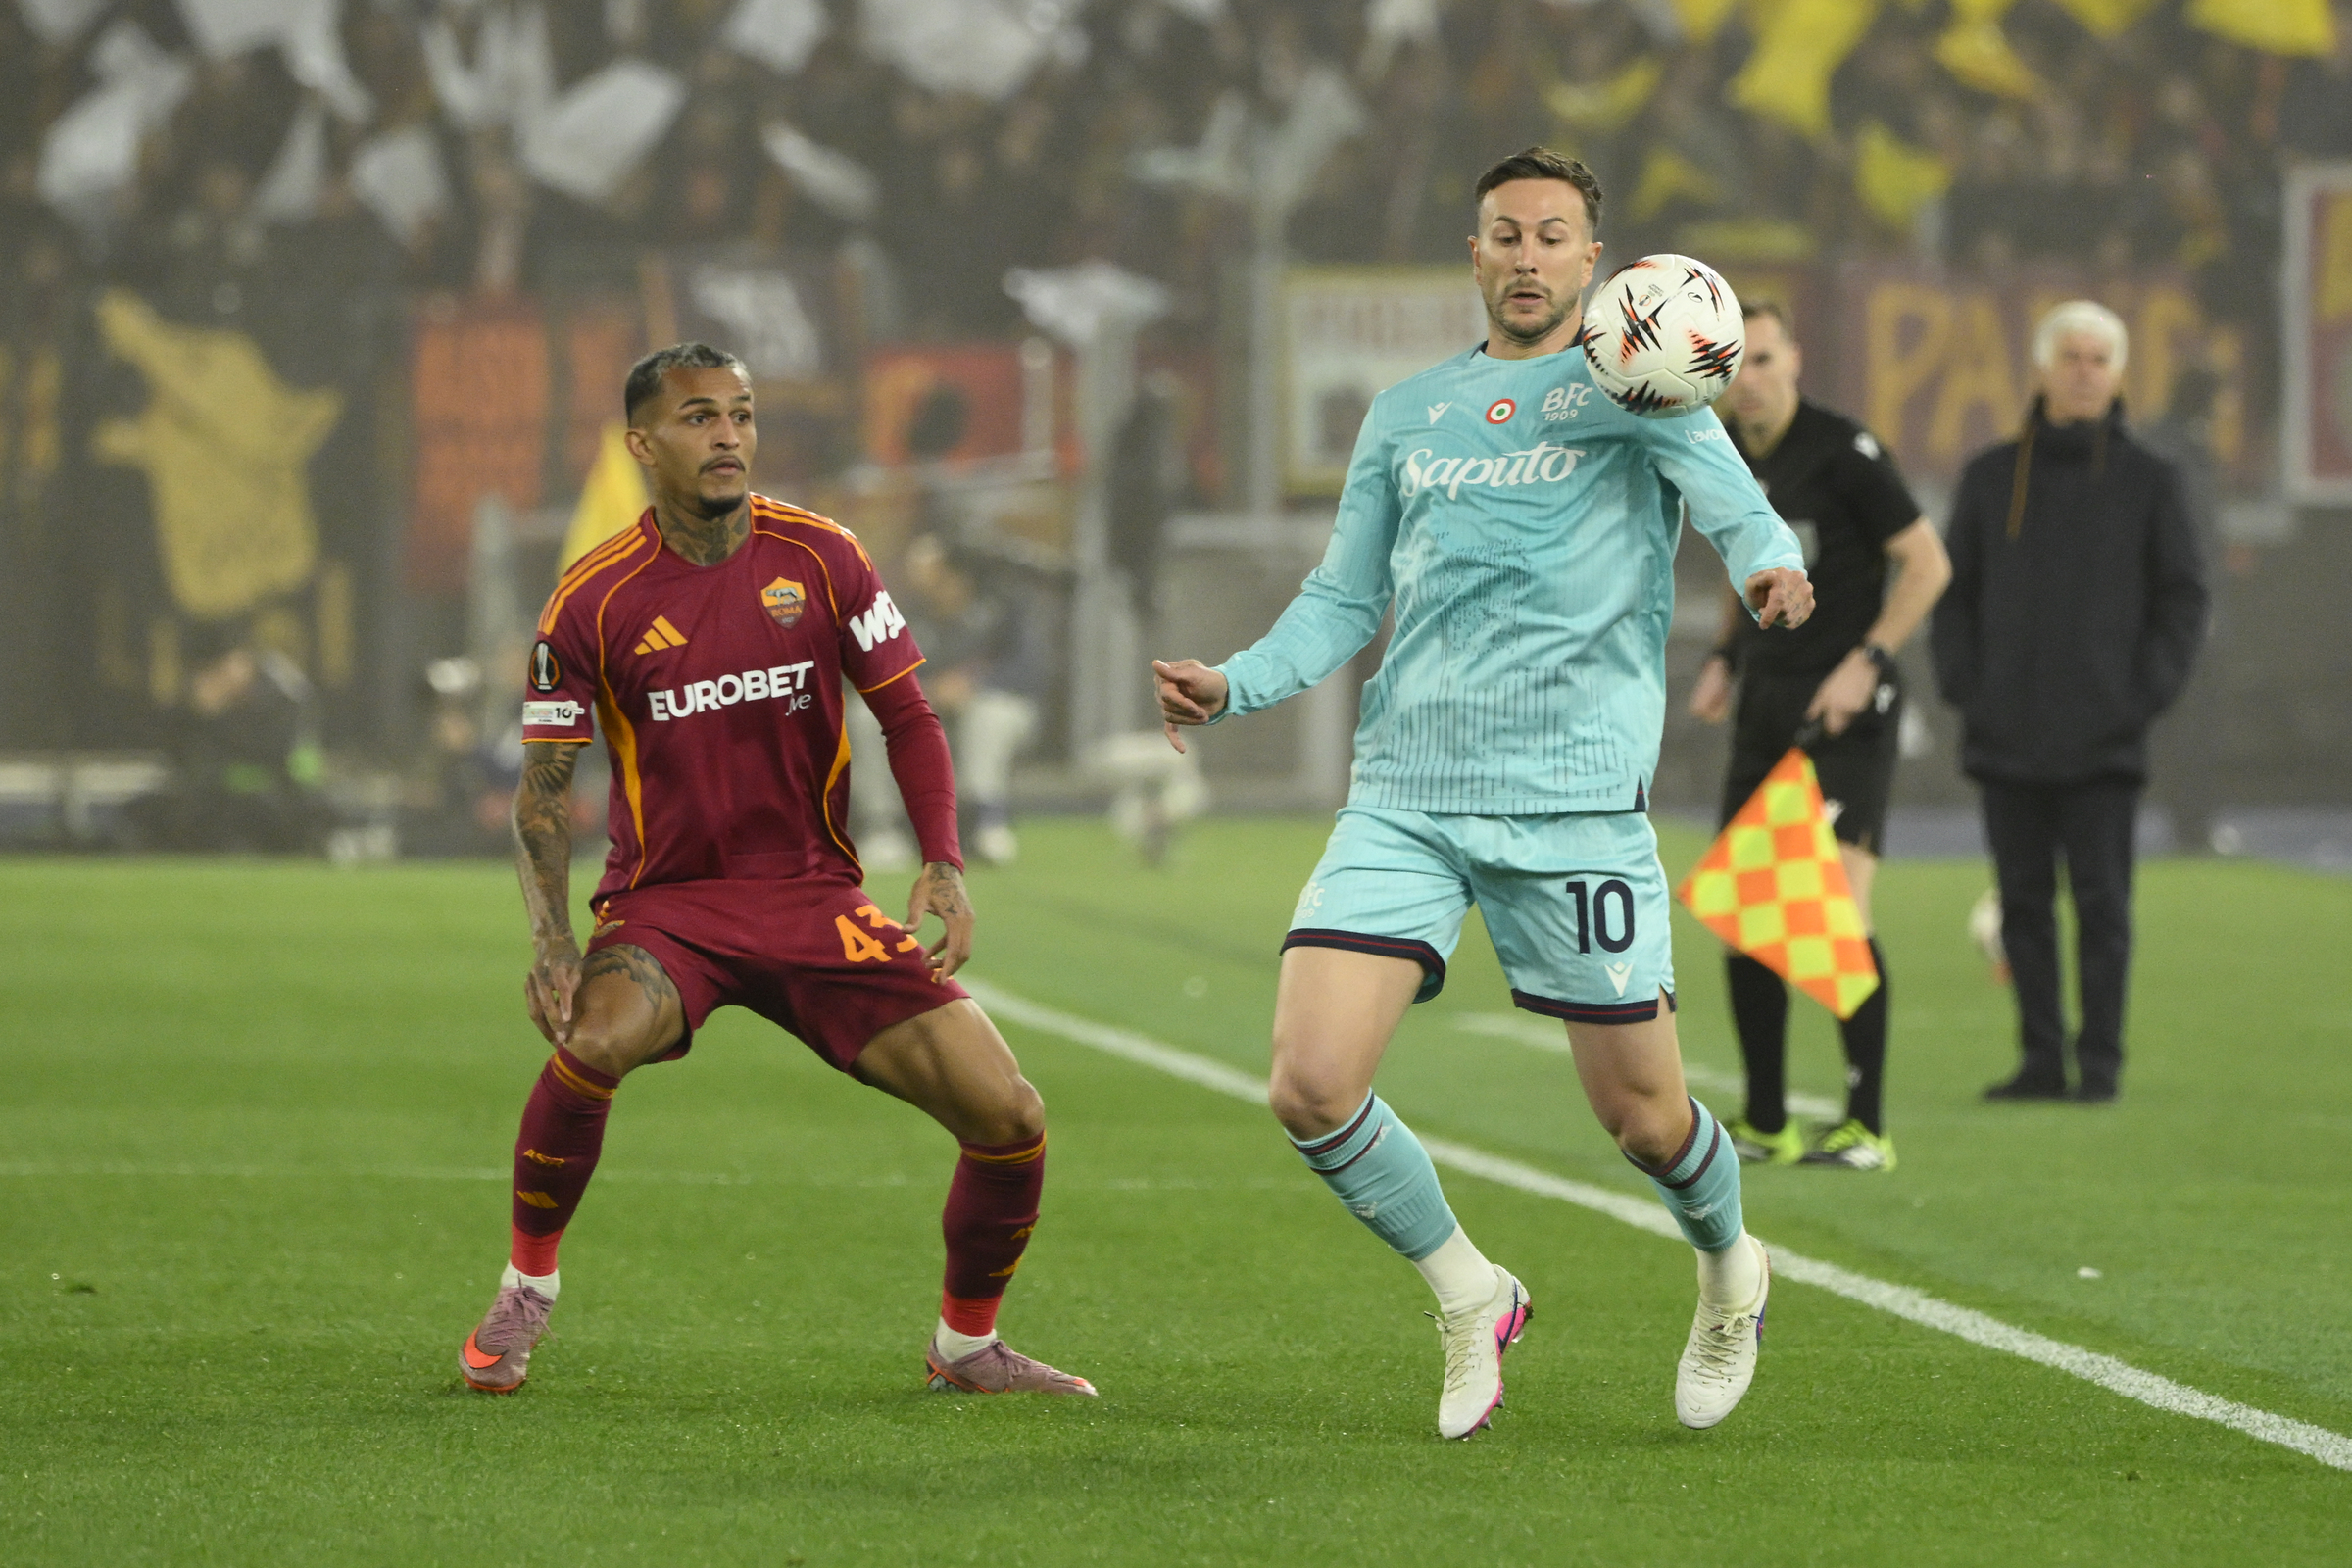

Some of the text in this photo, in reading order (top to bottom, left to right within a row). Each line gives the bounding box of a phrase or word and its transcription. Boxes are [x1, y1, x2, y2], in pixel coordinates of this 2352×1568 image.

[1541, 382, 1593, 412] BFC
[1544, 408, 1579, 421] 1909
[1403, 441, 1587, 501] Saputo
[770, 605, 803, 618] ROMA
[648, 661, 814, 721] EUROBET
[834, 904, 919, 963] 43
[1565, 879, 1636, 955] 10
